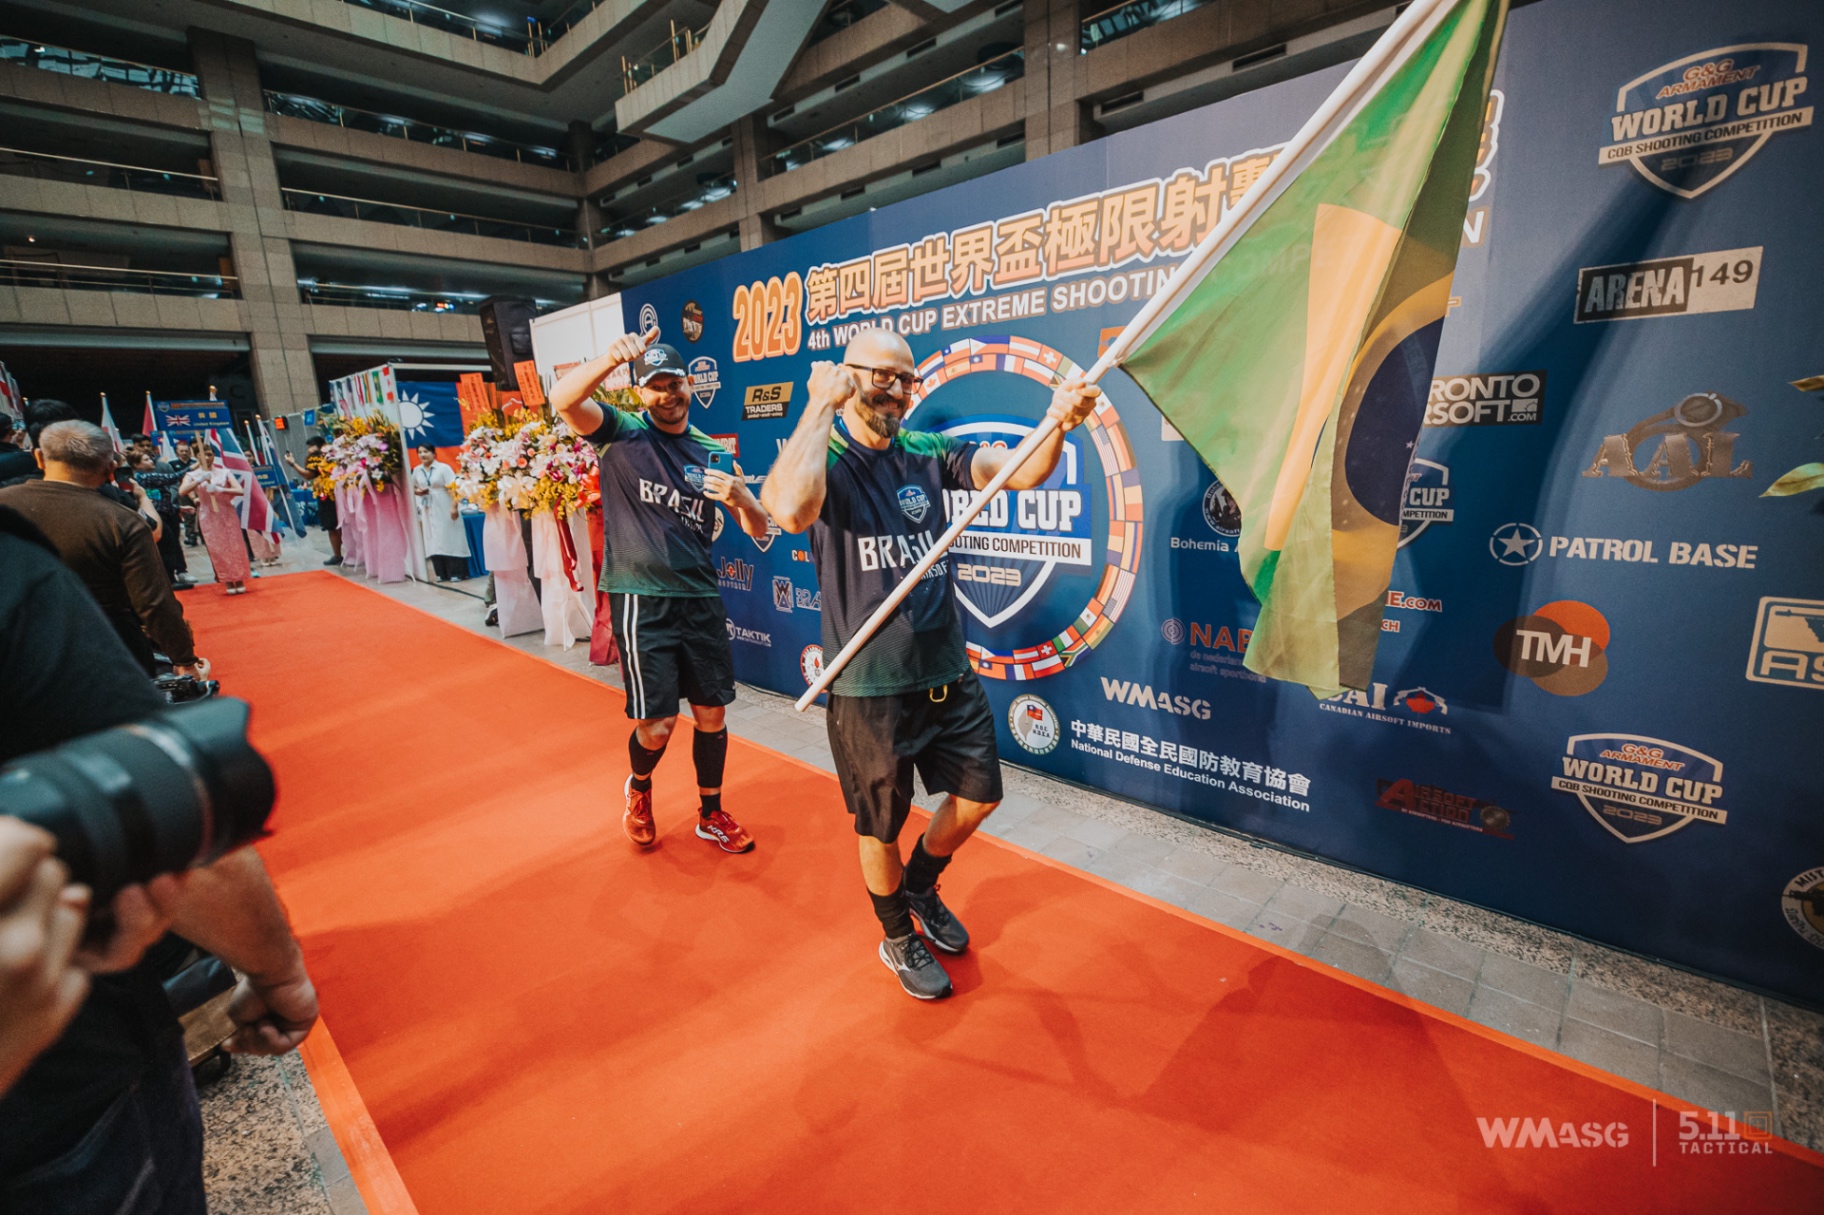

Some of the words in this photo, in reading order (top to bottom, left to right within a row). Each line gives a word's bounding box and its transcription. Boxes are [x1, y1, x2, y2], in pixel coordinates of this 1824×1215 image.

[1656, 65, 1761, 100] ARMAMENT
[1683, 58, 1735, 82] G&G
[1611, 94, 1728, 142] WORLD
[1736, 76, 1808, 117] CUP
[1607, 145, 1633, 159] CQB
[1636, 131, 1702, 154] SHOOTING
[1704, 112, 1802, 140] COMPETITION
[1661, 147, 1733, 171] 2023
[1584, 266, 1685, 313] ARENA
[1691, 259, 1754, 288] 149
[733, 271, 802, 363] 2023
[808, 330, 830, 350] 4th
[899, 310, 937, 335] CUP
[942, 290, 1046, 328] EXTREME
[1052, 266, 1179, 311] SHOOTIN
[752, 386, 782, 402] R&S
[1428, 374, 1540, 402] RONTO
[745, 403, 783, 414] TRADERS
[1582, 432, 1753, 478] AAL
[1017, 489, 1082, 532] CUP
[1409, 487, 1450, 506] CUP
[993, 537, 1081, 559] COMPETITION
[1170, 537, 1230, 552] Bohemia
[1549, 536, 1659, 564] PATROL
[1669, 542, 1759, 569] BASE
[717, 556, 754, 591] Jolly
[957, 563, 1022, 586] 2023
[735, 626, 772, 643] TAKTIK
[1516, 629, 1592, 668] TMH
[1100, 676, 1211, 720] WMASG
[1319, 703, 1363, 717] CANADIAN
[1366, 711, 1405, 726] AIRSOFT
[1407, 720, 1452, 735] IMPORTS
[1071, 719, 1311, 797] 中華民國全民國防教育協會
[1600, 749, 1685, 772] ARMAMENT
[1622, 743, 1664, 759] G&G
[1071, 738, 1113, 760] National
[1116, 750, 1161, 773] Defense
[1164, 763, 1226, 789] Education
[1228, 780, 1310, 812] Association
[1562, 756, 1659, 793] WORLD
[1665, 776, 1724, 805] CUP
[1558, 780, 1580, 791] CQB
[1582, 785, 1636, 803] SHOOTING
[1639, 797, 1719, 819] COMPETITION
[1603, 804, 1663, 826] 2023
